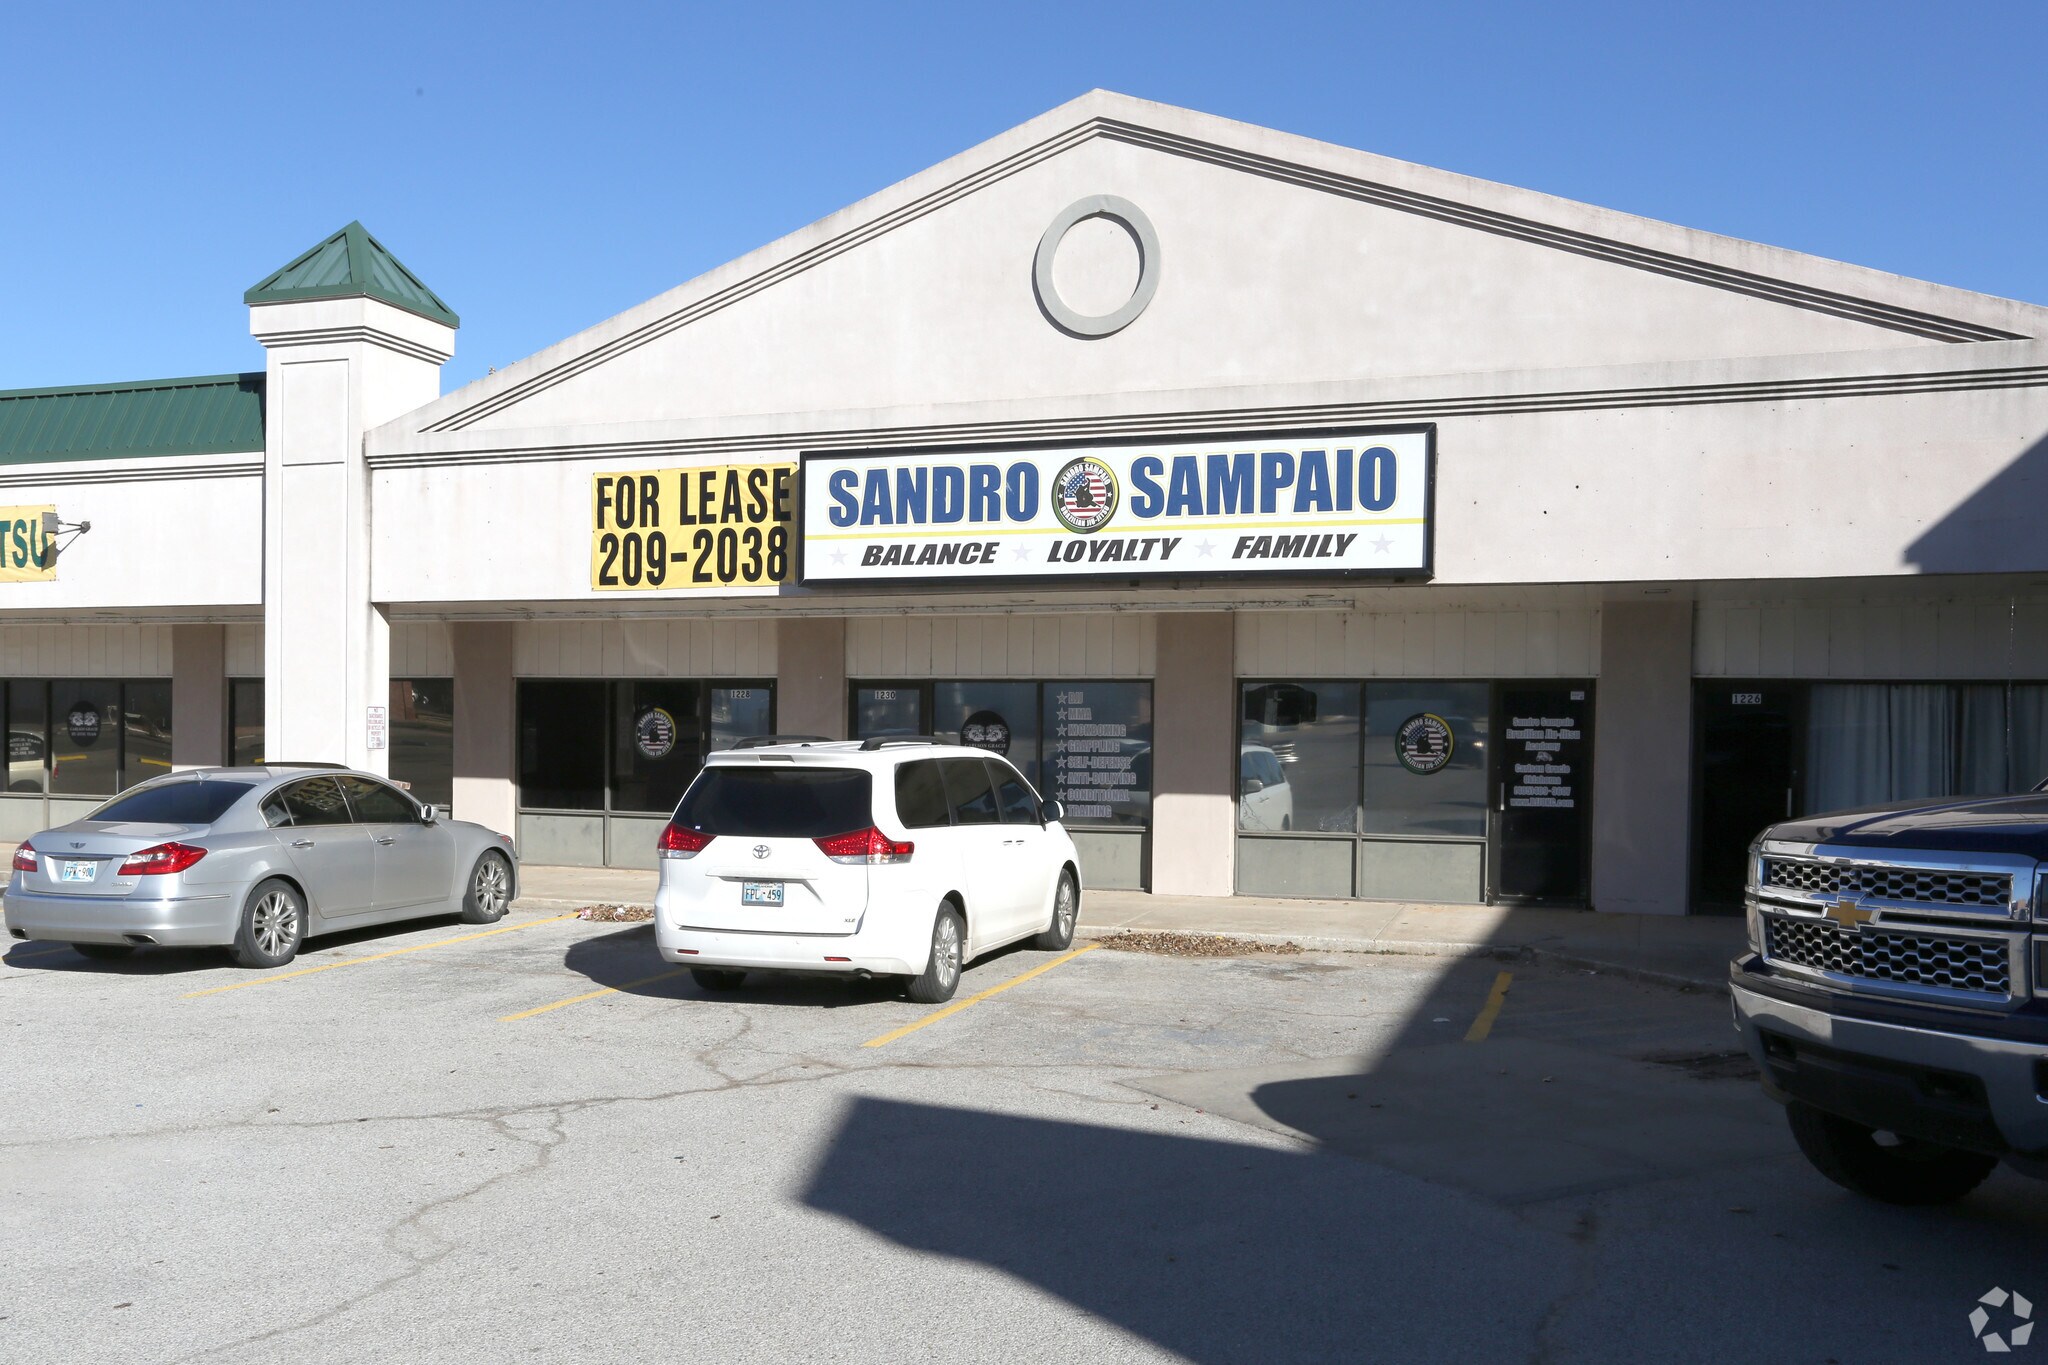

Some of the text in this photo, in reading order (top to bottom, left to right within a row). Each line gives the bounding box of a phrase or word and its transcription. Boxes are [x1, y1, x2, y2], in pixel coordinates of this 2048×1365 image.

[1060, 463, 1111, 487] SANDRO SAMPAIO
[828, 446, 1397, 527] SANDRO SAMPAIO
[597, 468, 792, 530] FOR LEASE
[1060, 505, 1110, 527] BRAZILIAN JIU-JITSU
[599, 526, 788, 586] 209-2038
[861, 533, 1358, 567] BALANCE LOYALTY FAMILY
[731, 690, 751, 699] 1228
[875, 690, 896, 700] 1230
[1733, 694, 1761, 704] 1226
[1068, 708, 1092, 720] MMA
[1068, 724, 1126, 737] KICKBOXING
[1403, 718, 1447, 737] SANDRO SAMPAIO
[1068, 740, 1120, 752] GRAPPLING
[1067, 756, 1131, 769] SELF-DEFENSE
[1067, 772, 1136, 785] ANTI-BULLYING
[1067, 788, 1130, 802] CONDITIONAL
[1067, 804, 1112, 818] TRAINING
